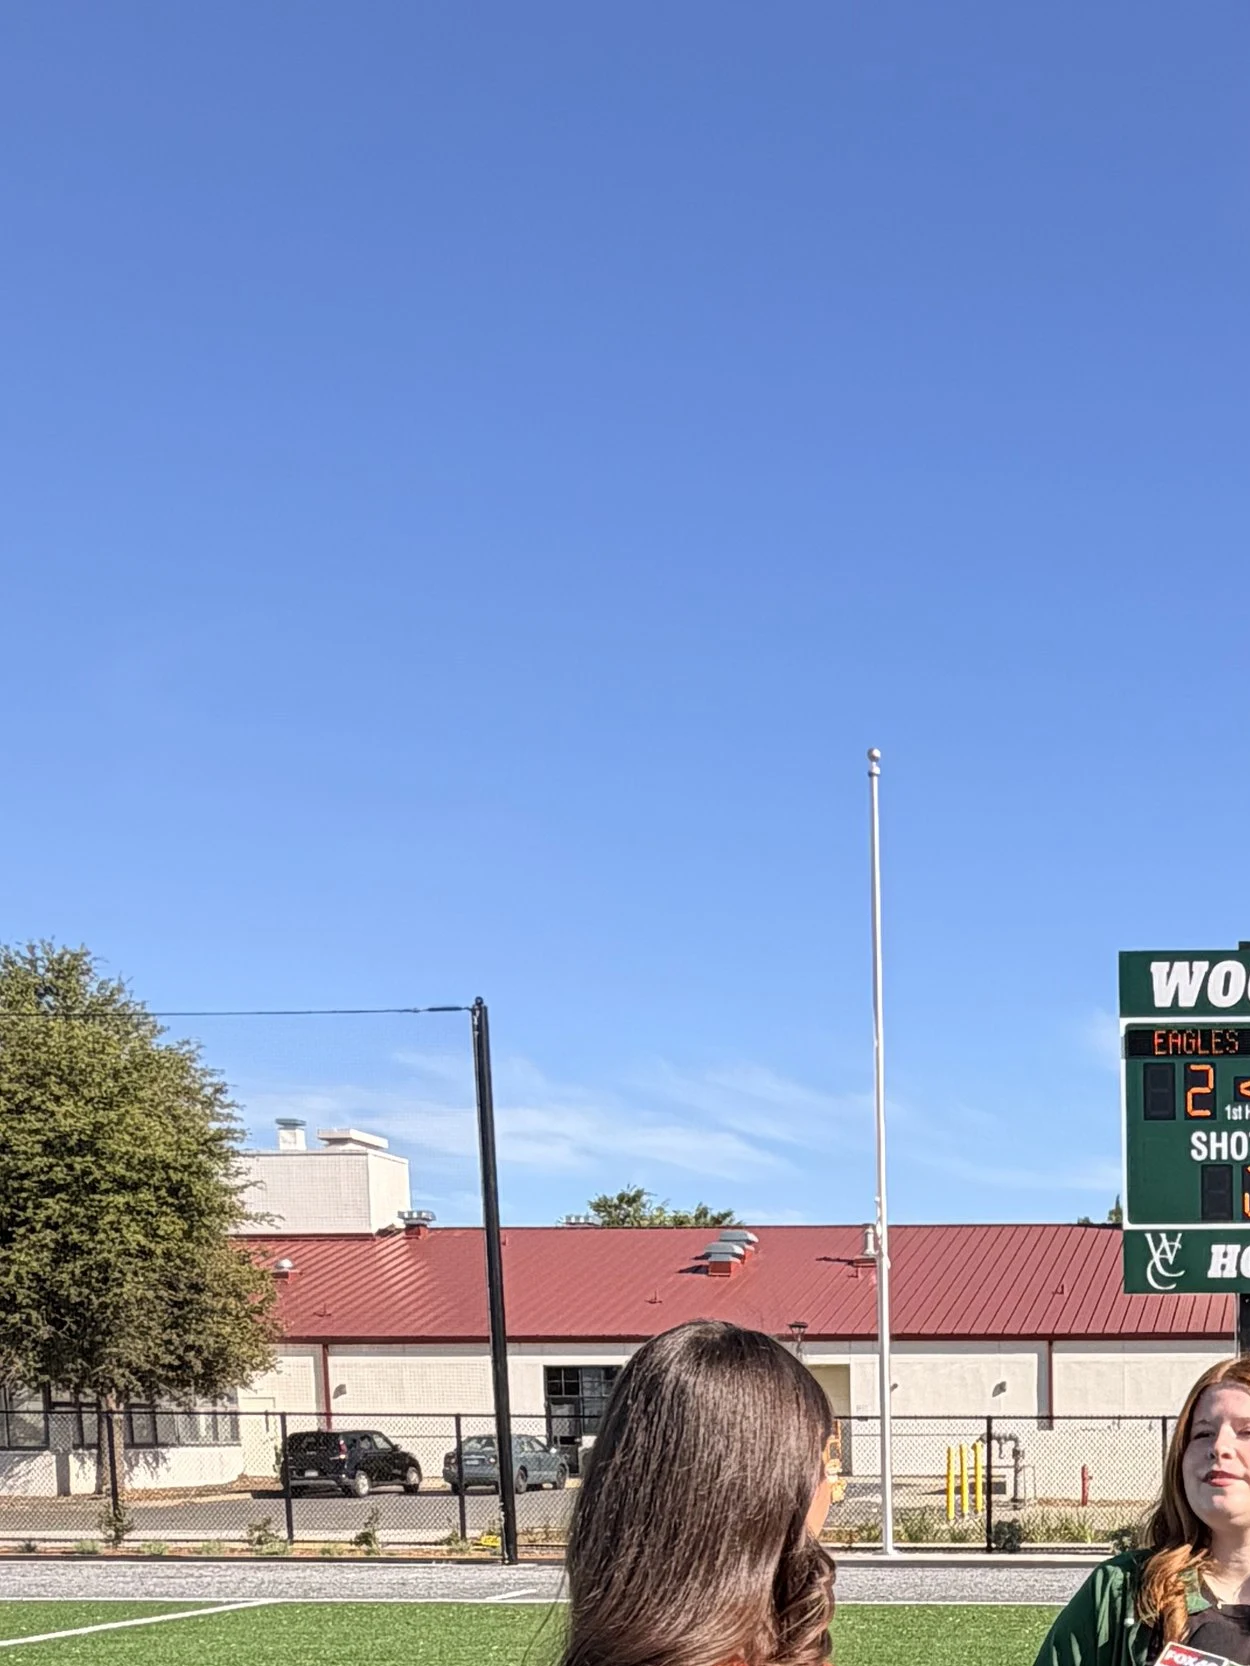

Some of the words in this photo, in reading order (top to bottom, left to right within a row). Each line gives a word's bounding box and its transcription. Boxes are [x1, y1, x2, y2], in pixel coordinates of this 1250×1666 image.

[1153, 1029, 1240, 1055] EAGLES
[1186, 1064, 1215, 1117] 2
[1224, 1104, 1243, 1121] 1st
